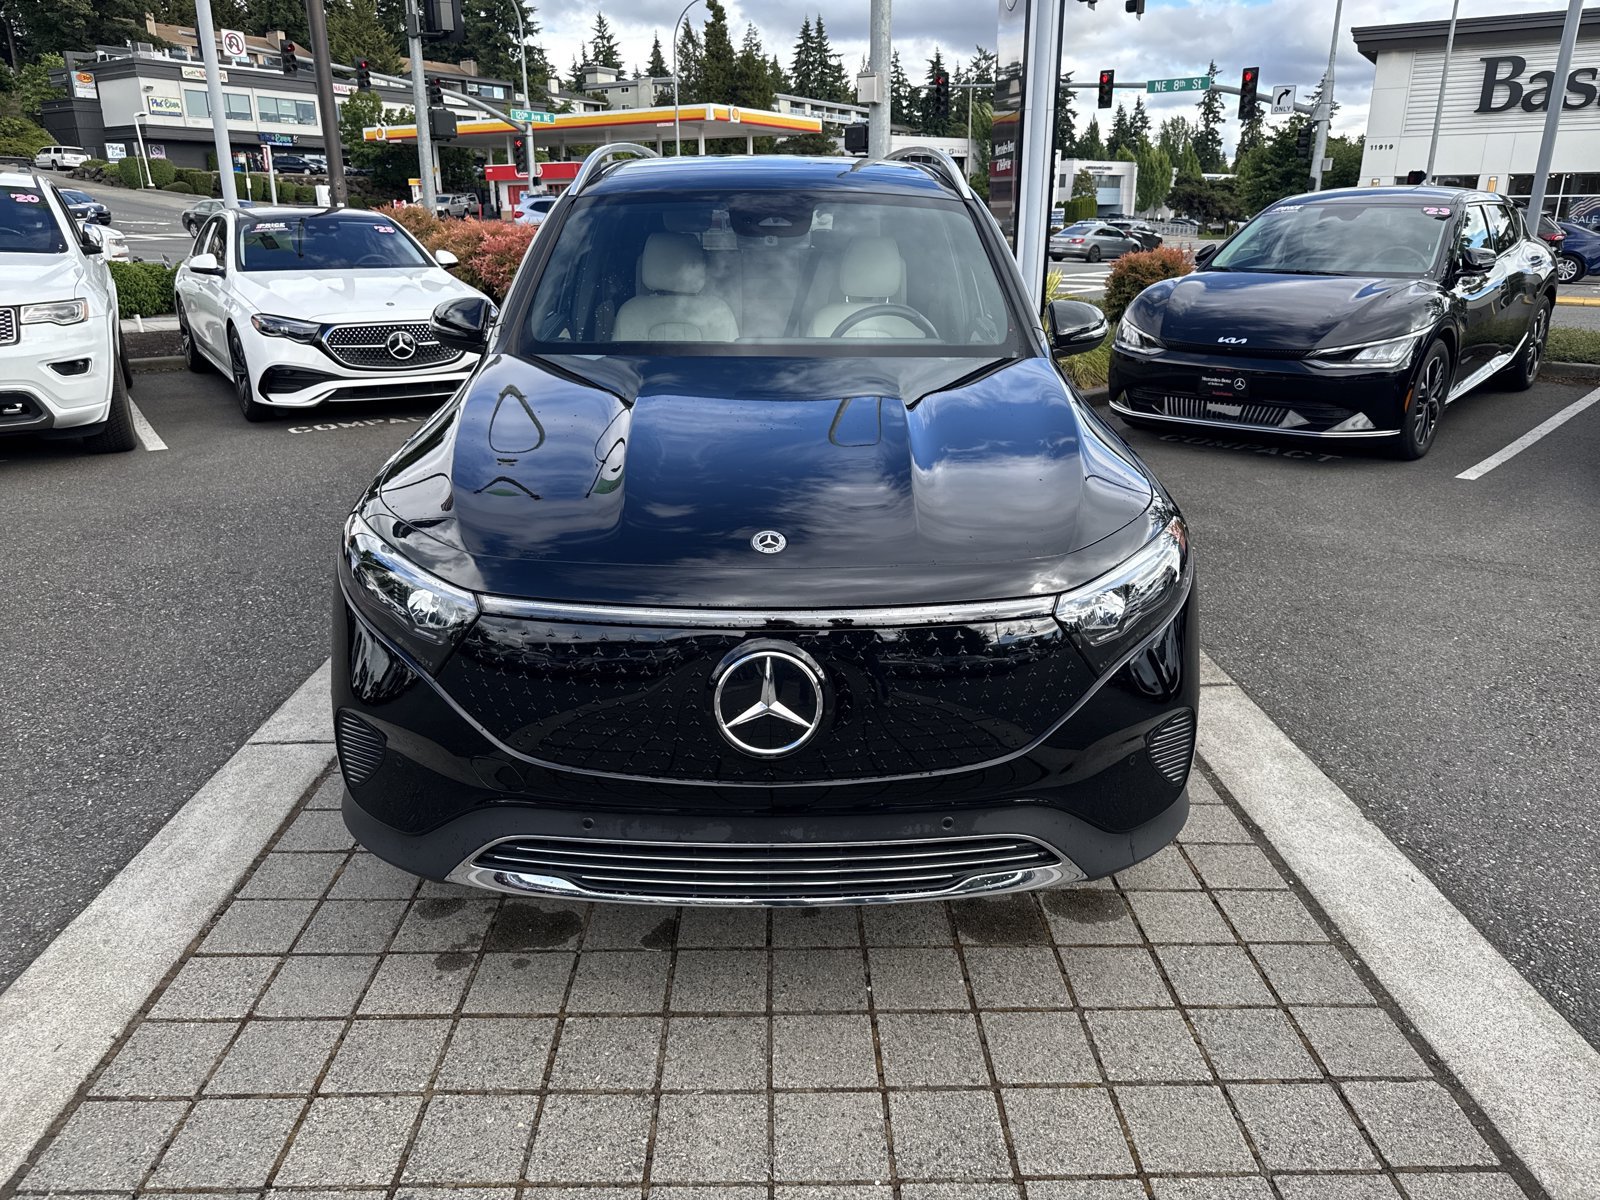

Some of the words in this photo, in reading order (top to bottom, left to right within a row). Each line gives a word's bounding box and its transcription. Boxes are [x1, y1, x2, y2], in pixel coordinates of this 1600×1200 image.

[1155, 81, 1167, 91] NE
[1173, 80, 1186, 90] 8th
[1192, 79, 1201, 89] St
[1474, 56, 1600, 112] Bas
[531, 112, 541, 122] Ave
[543, 114, 551, 122] NE
[1571, 215, 1599, 224] SALE
[1217, 336, 1248, 344] KIA
[288, 416, 428, 434] COMPAC
[1159, 434, 1343, 462] COMPACT
